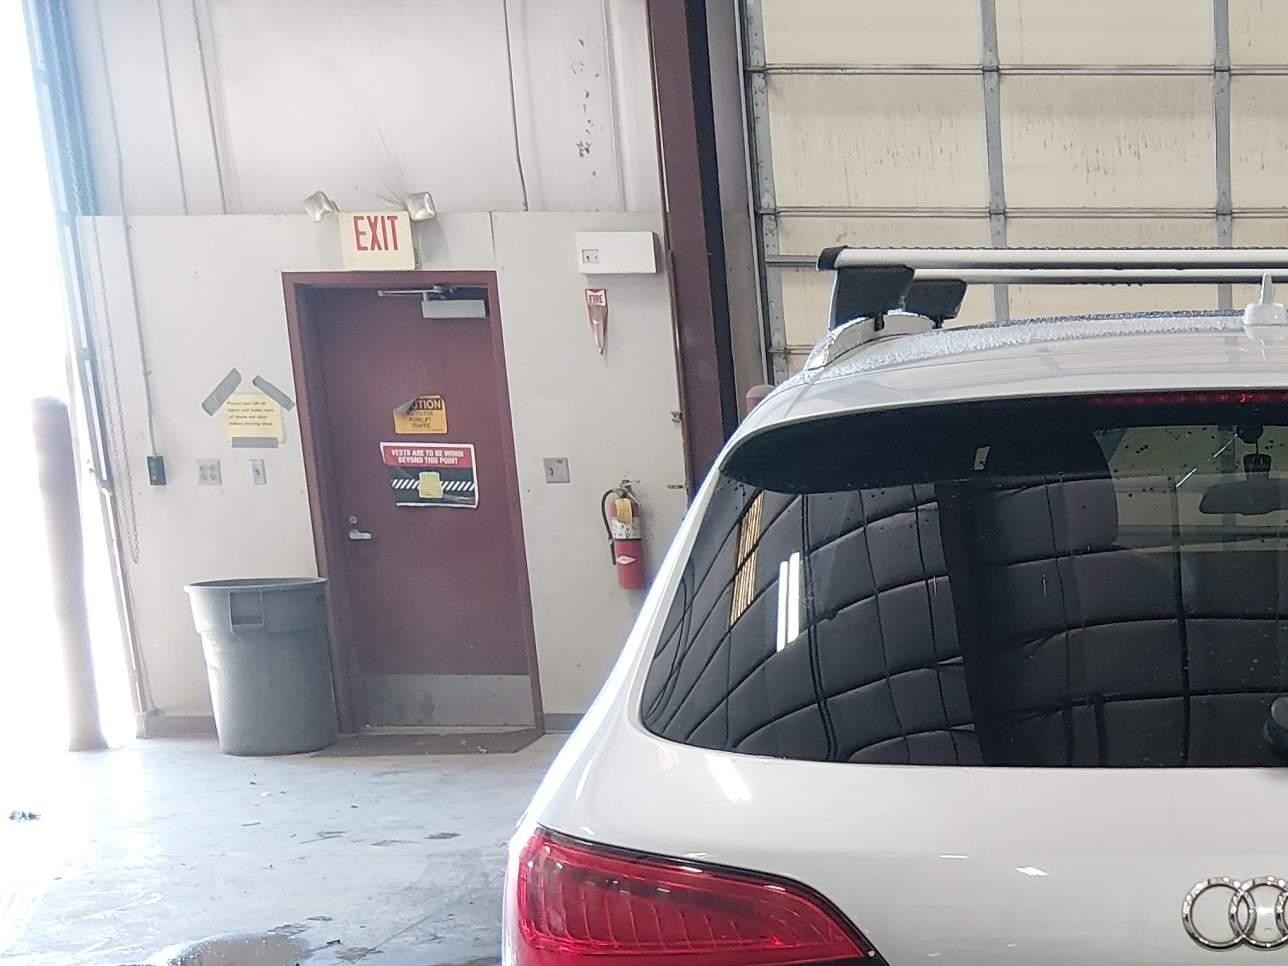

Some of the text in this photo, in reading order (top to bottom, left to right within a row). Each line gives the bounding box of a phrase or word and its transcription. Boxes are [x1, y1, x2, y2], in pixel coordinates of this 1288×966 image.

[353, 215, 399, 251] EXIT
[589, 294, 604, 304] FIRE
[413, 399, 441, 409] UTION
[412, 449, 425, 457] ARE
[425, 449, 434, 457] TO
[398, 456, 423, 464] BEYOND
[439, 457, 458, 465] POINT
